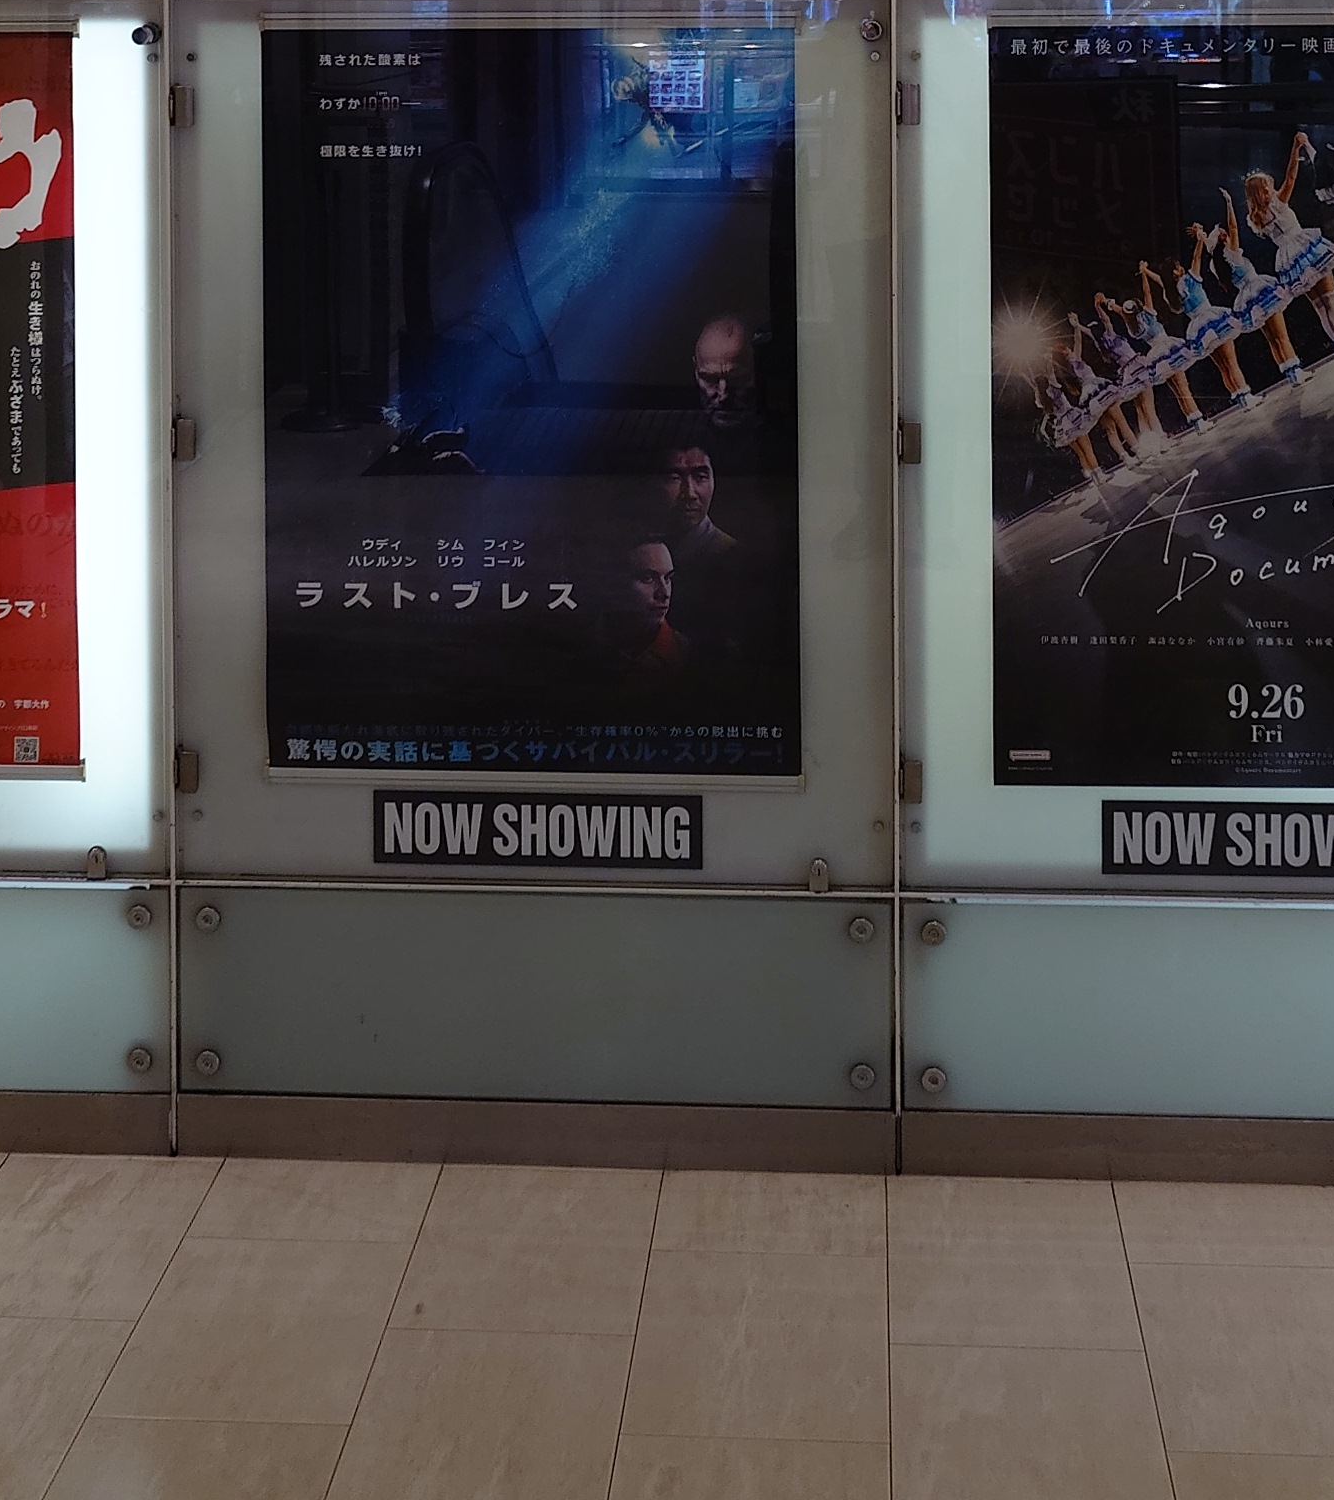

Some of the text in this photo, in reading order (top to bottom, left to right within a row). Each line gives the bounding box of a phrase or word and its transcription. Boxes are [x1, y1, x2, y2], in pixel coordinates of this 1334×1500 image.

[318, 53, 422, 67] 残された酸素は
[319, 144, 423, 158] 極限を生き抜け!
[361, 539, 526, 552] ウディ シム フィン
[347, 555, 526, 569] ハレルソン リウ コール
[295, 581, 579, 610] ラスト・ブレス
[1245, 617, 1290, 631] Aqours
[1226, 683, 1306, 720] 9.26
[1251, 725, 1284, 744] Fri
[384, 801, 692, 860] NOW SHOWING
[1113, 811, 1218, 866] NOW
